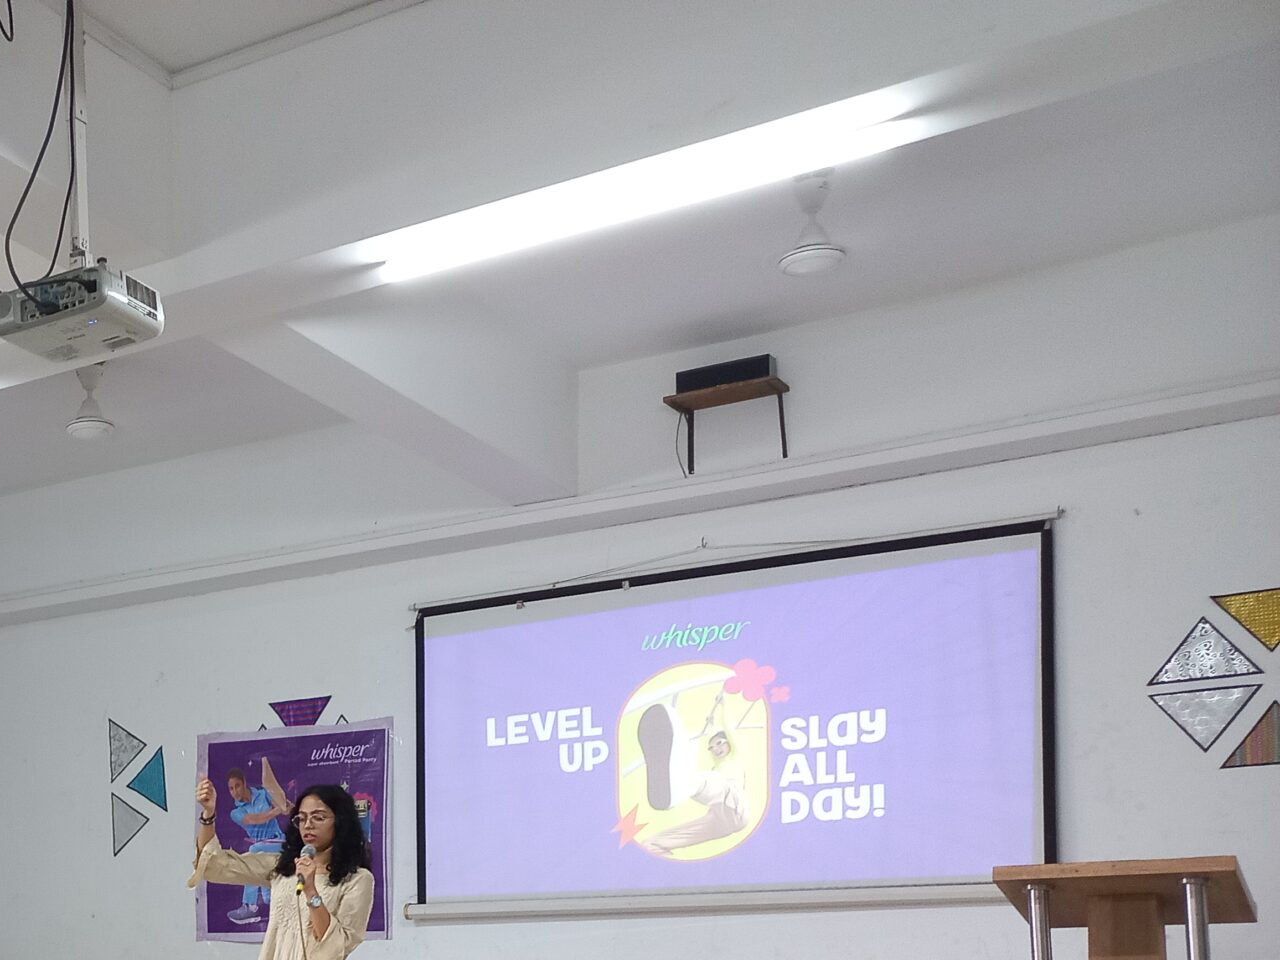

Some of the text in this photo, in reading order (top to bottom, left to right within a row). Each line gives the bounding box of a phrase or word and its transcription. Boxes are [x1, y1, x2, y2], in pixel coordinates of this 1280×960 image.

[641, 619, 751, 652] whisper
[486, 706, 603, 748] LEVEL
[311, 743, 370, 762] whisper
[559, 739, 608, 773] UP
[778, 747, 856, 787] ALL
